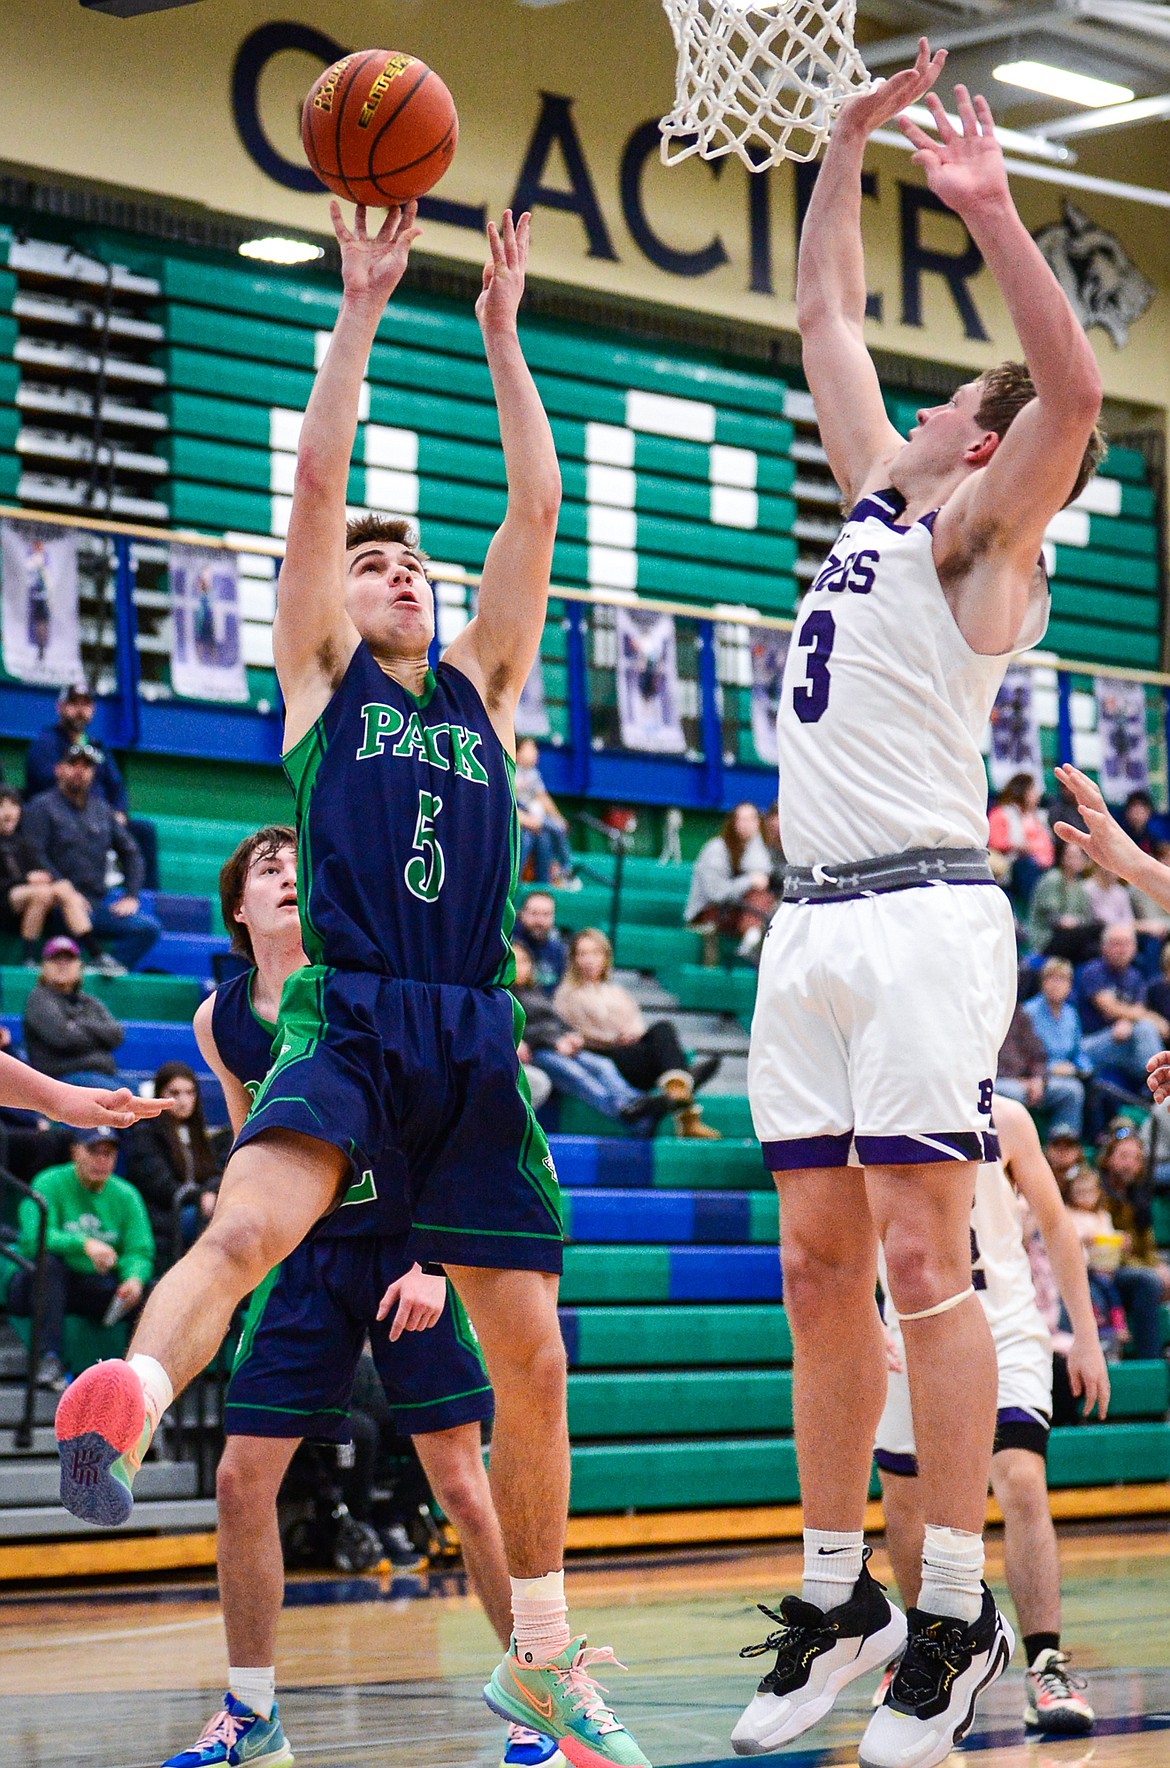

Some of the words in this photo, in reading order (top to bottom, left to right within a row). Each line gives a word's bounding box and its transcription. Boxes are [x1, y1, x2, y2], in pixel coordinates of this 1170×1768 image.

[793, 609, 836, 724] 3
[356, 702, 489, 787] PACK
[404, 789, 446, 903] 5
